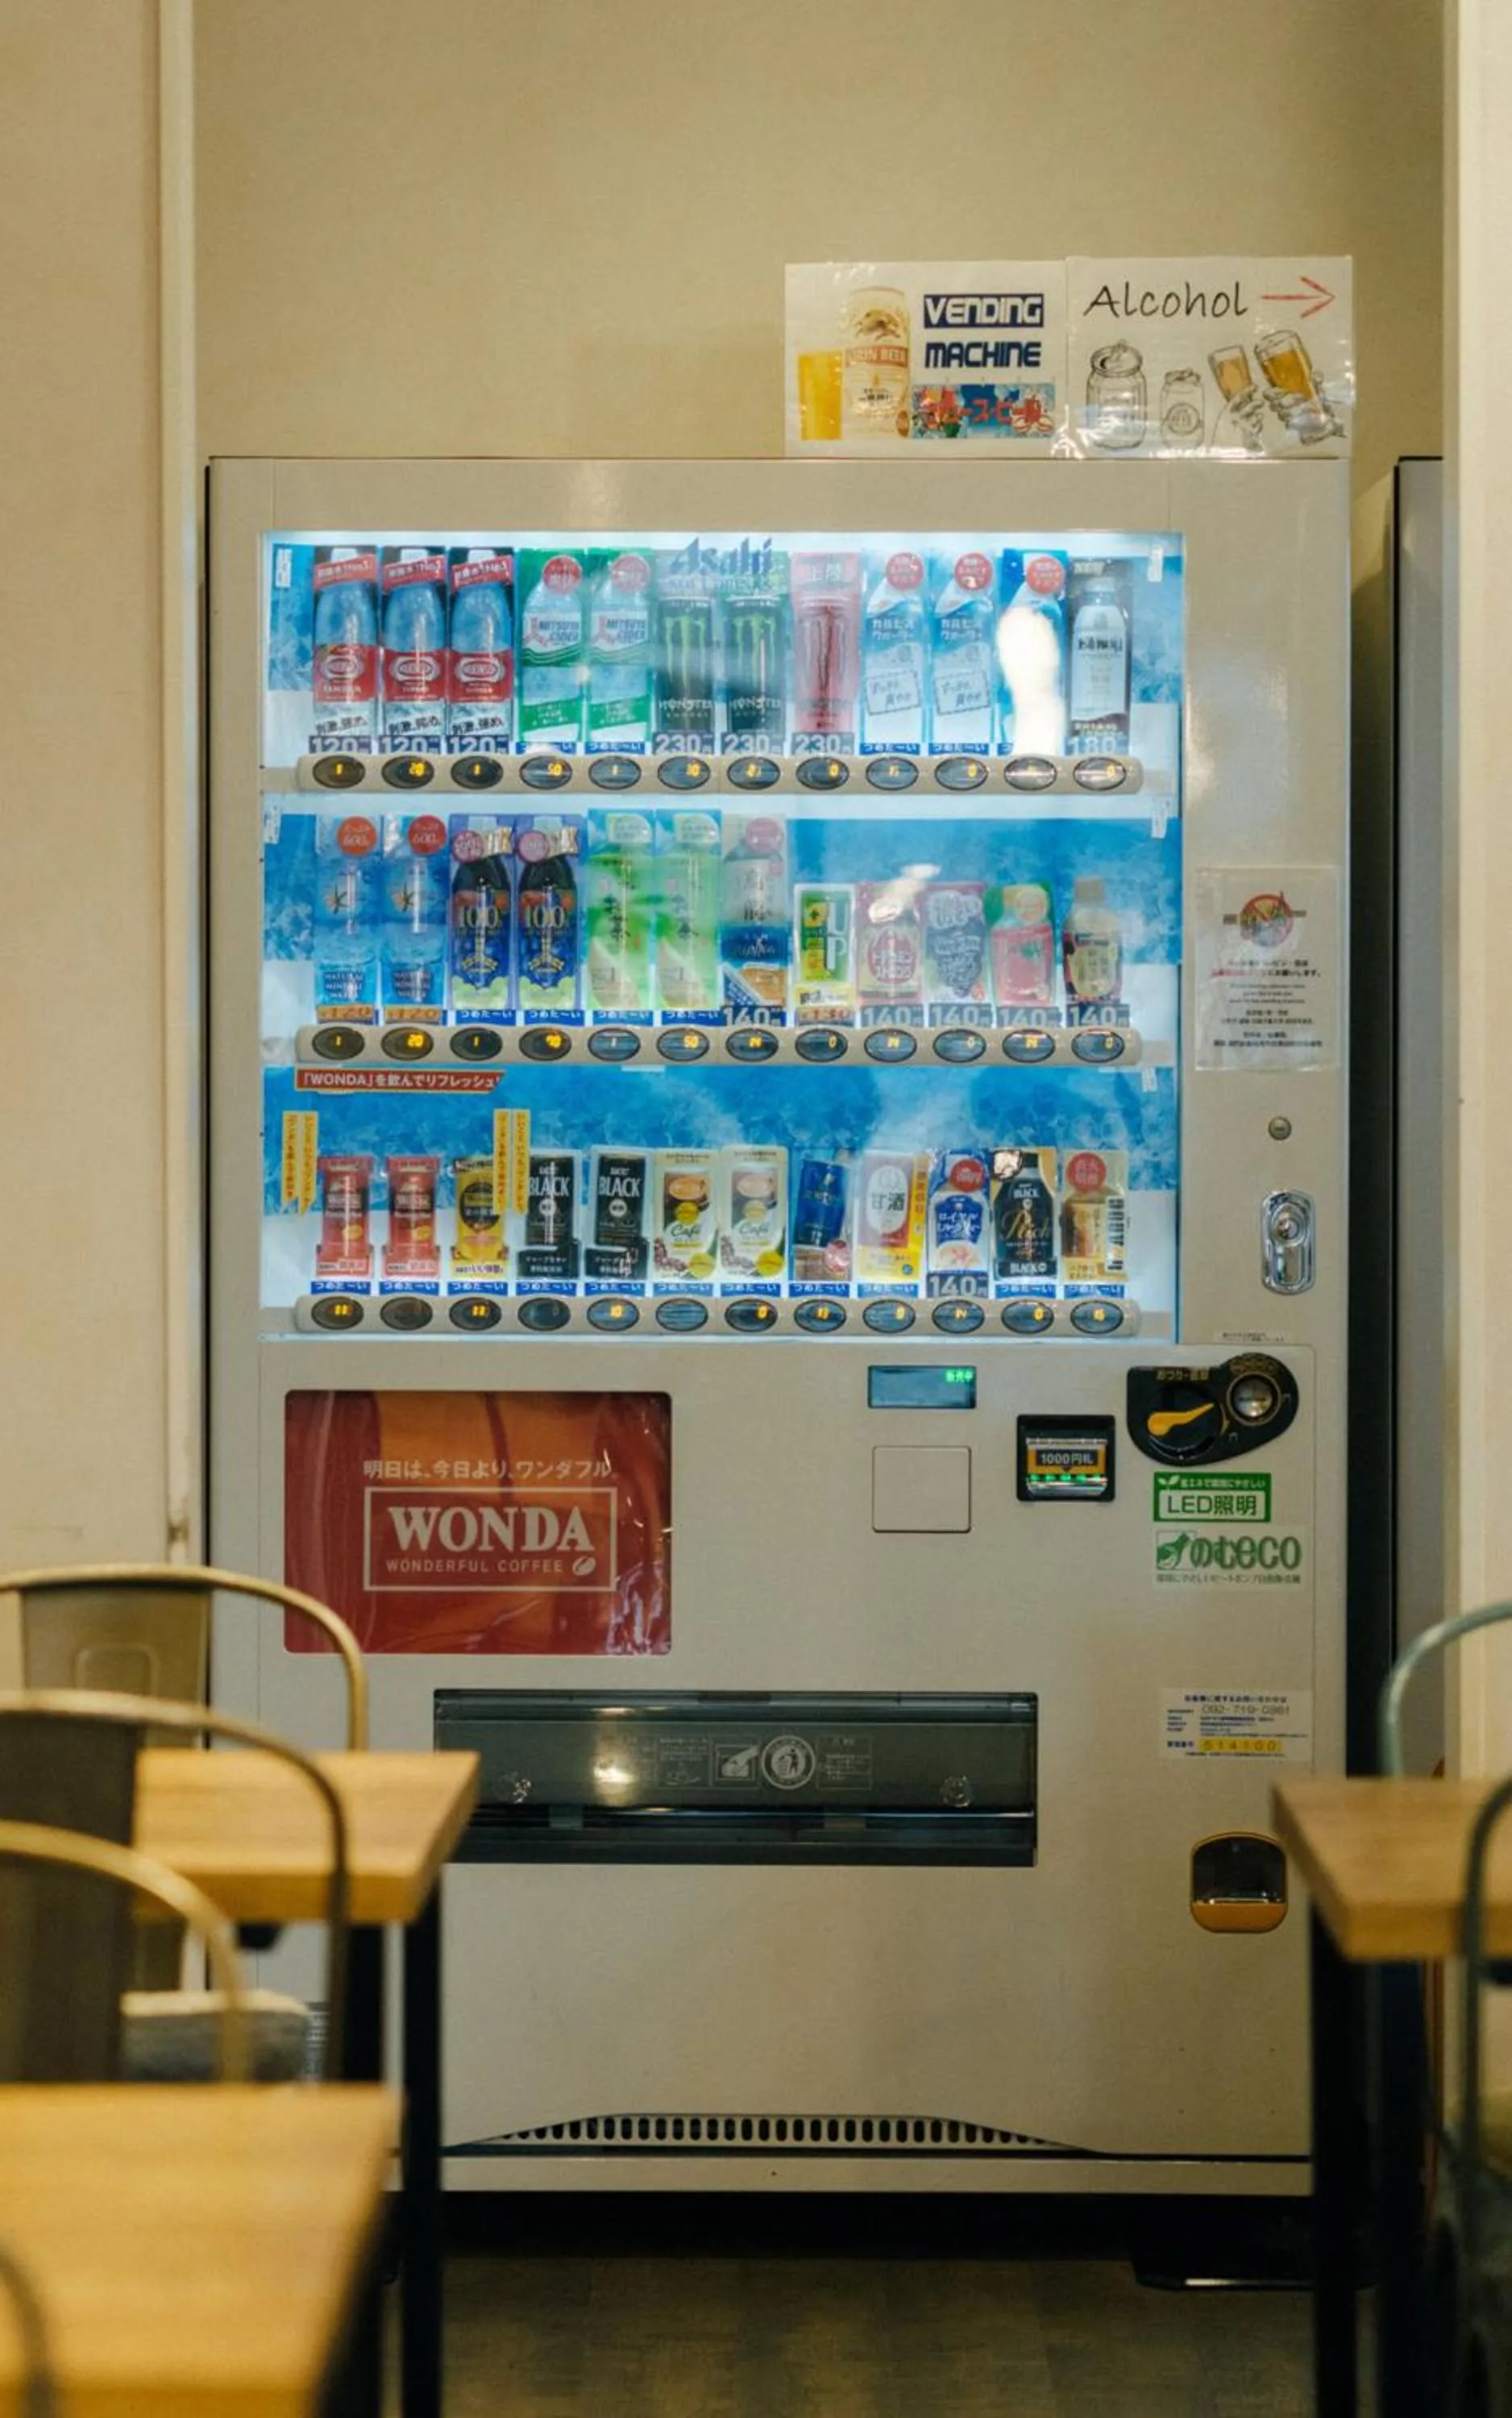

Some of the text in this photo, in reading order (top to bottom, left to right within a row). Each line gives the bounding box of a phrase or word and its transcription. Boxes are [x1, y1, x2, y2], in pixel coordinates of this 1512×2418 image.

[1083, 281, 1248, 318] Alcohol
[927, 297, 1042, 326] VENDING
[925, 342, 1041, 368] MACHINE
[600, 1177, 640, 1197] BLACK
[870, 1192, 905, 1211] 甘酒
[1167, 1495, 1257, 1515] LED照明
[388, 1506, 596, 1552] WONDA
[386, 1559, 563, 1573] WONDERFUL COFFEE
